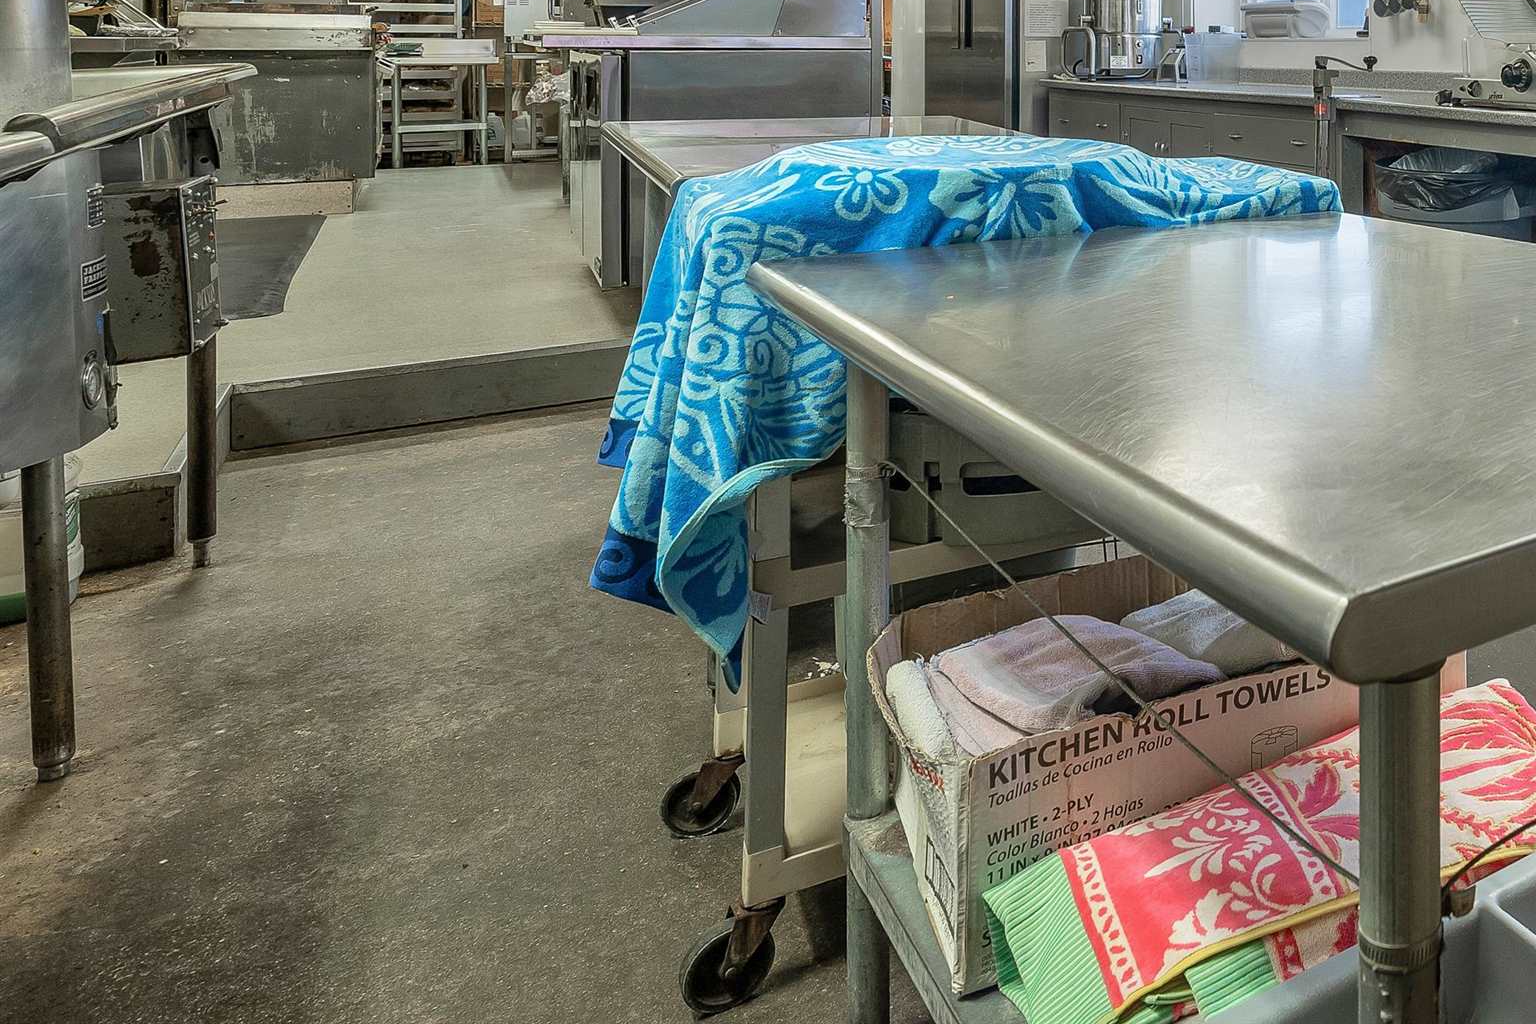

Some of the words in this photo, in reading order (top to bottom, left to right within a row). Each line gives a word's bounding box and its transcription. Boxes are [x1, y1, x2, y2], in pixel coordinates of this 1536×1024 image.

[988, 720, 1124, 789] KITCHEN
[1132, 698, 1210, 739] ROLL
[1216, 668, 1332, 714] TOWELS
[988, 780, 1039, 809] Toallas
[1042, 770, 1060, 786] de
[1064, 753, 1113, 779] Cocina
[1117, 749, 1134, 762] en
[1138, 735, 1173, 758] Rollo
[987, 815, 1038, 847] WHITE
[1053, 794, 1095, 821] 2-PLY
[987, 841, 1027, 867] Color
[1031, 820, 1079, 850] Blanco
[1091, 810, 1100, 825] 2
[1103, 798, 1144, 820] Hojas
[987, 866, 1004, 884] 11
